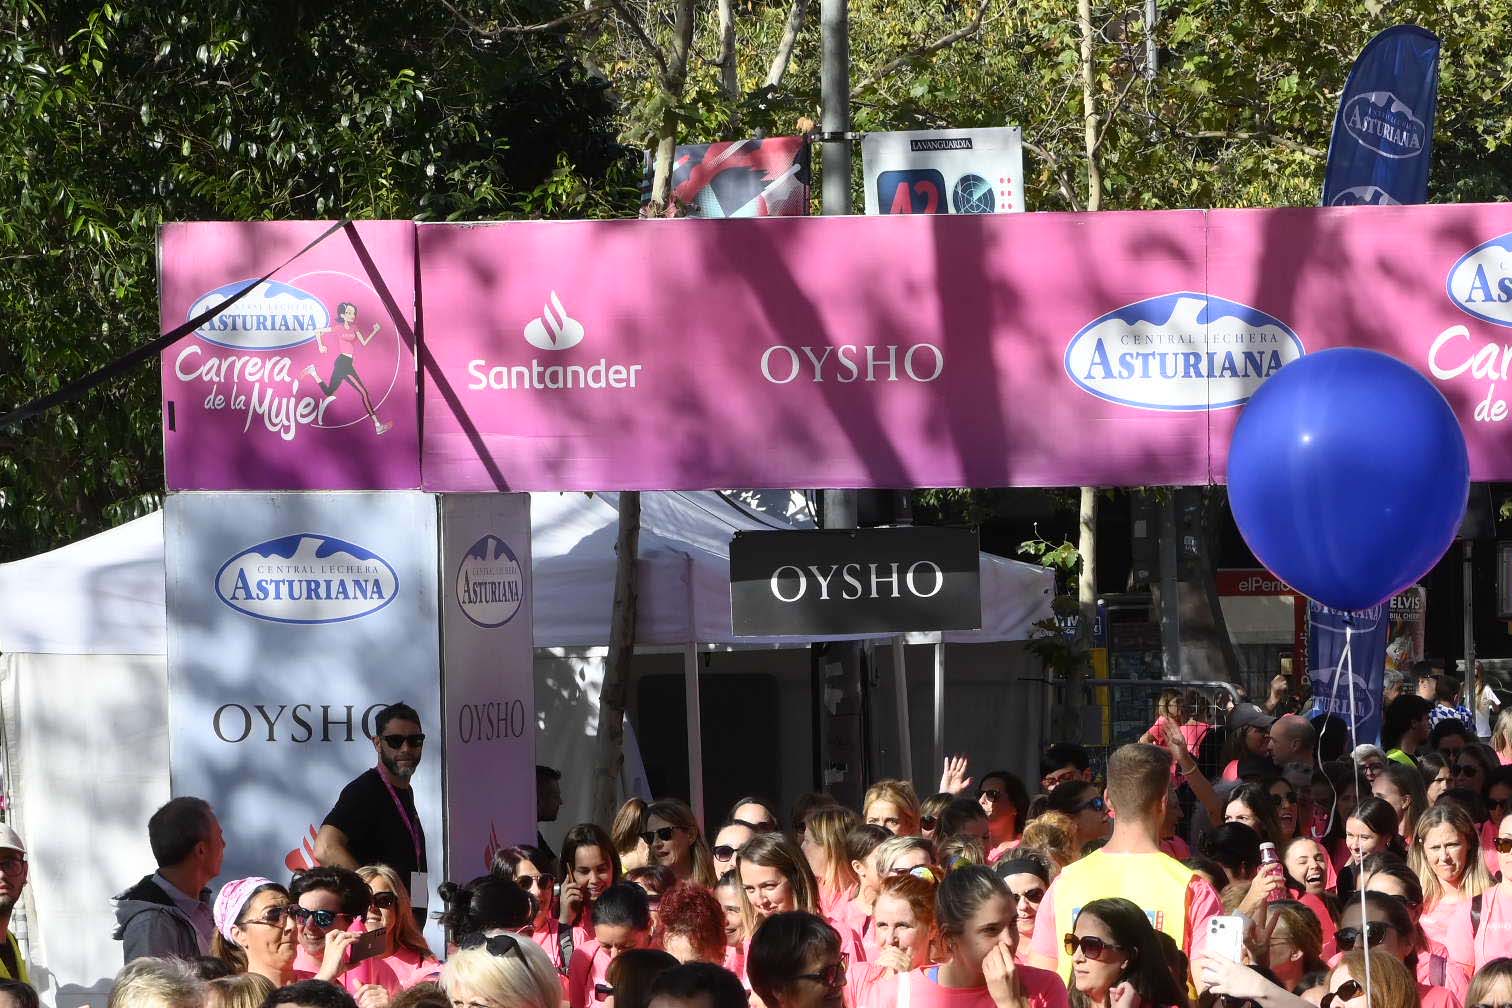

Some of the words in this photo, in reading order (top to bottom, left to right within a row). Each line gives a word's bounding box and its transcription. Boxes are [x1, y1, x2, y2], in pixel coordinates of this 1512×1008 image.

[1120, 332, 1200, 345] CENTRAL
[1206, 332, 1279, 344] LECHERA
[175, 344, 295, 383] Carrera
[467, 358, 642, 390] Santander
[760, 342, 944, 384] OYSHO
[1086, 335, 1283, 382] ASTURIANA
[204, 390, 227, 411] de
[230, 388, 247, 411] la
[244, 380, 337, 440] Mujer
[1474, 383, 1508, 422] de
[230, 567, 386, 601] ASTURIANA
[257, 565, 316, 574] CENTRAL
[321, 565, 379, 574] LECHERA
[462, 569, 519, 604] ASTURIANA
[769, 560, 944, 602] OYSHO
[459, 699, 524, 743] OYSHO
